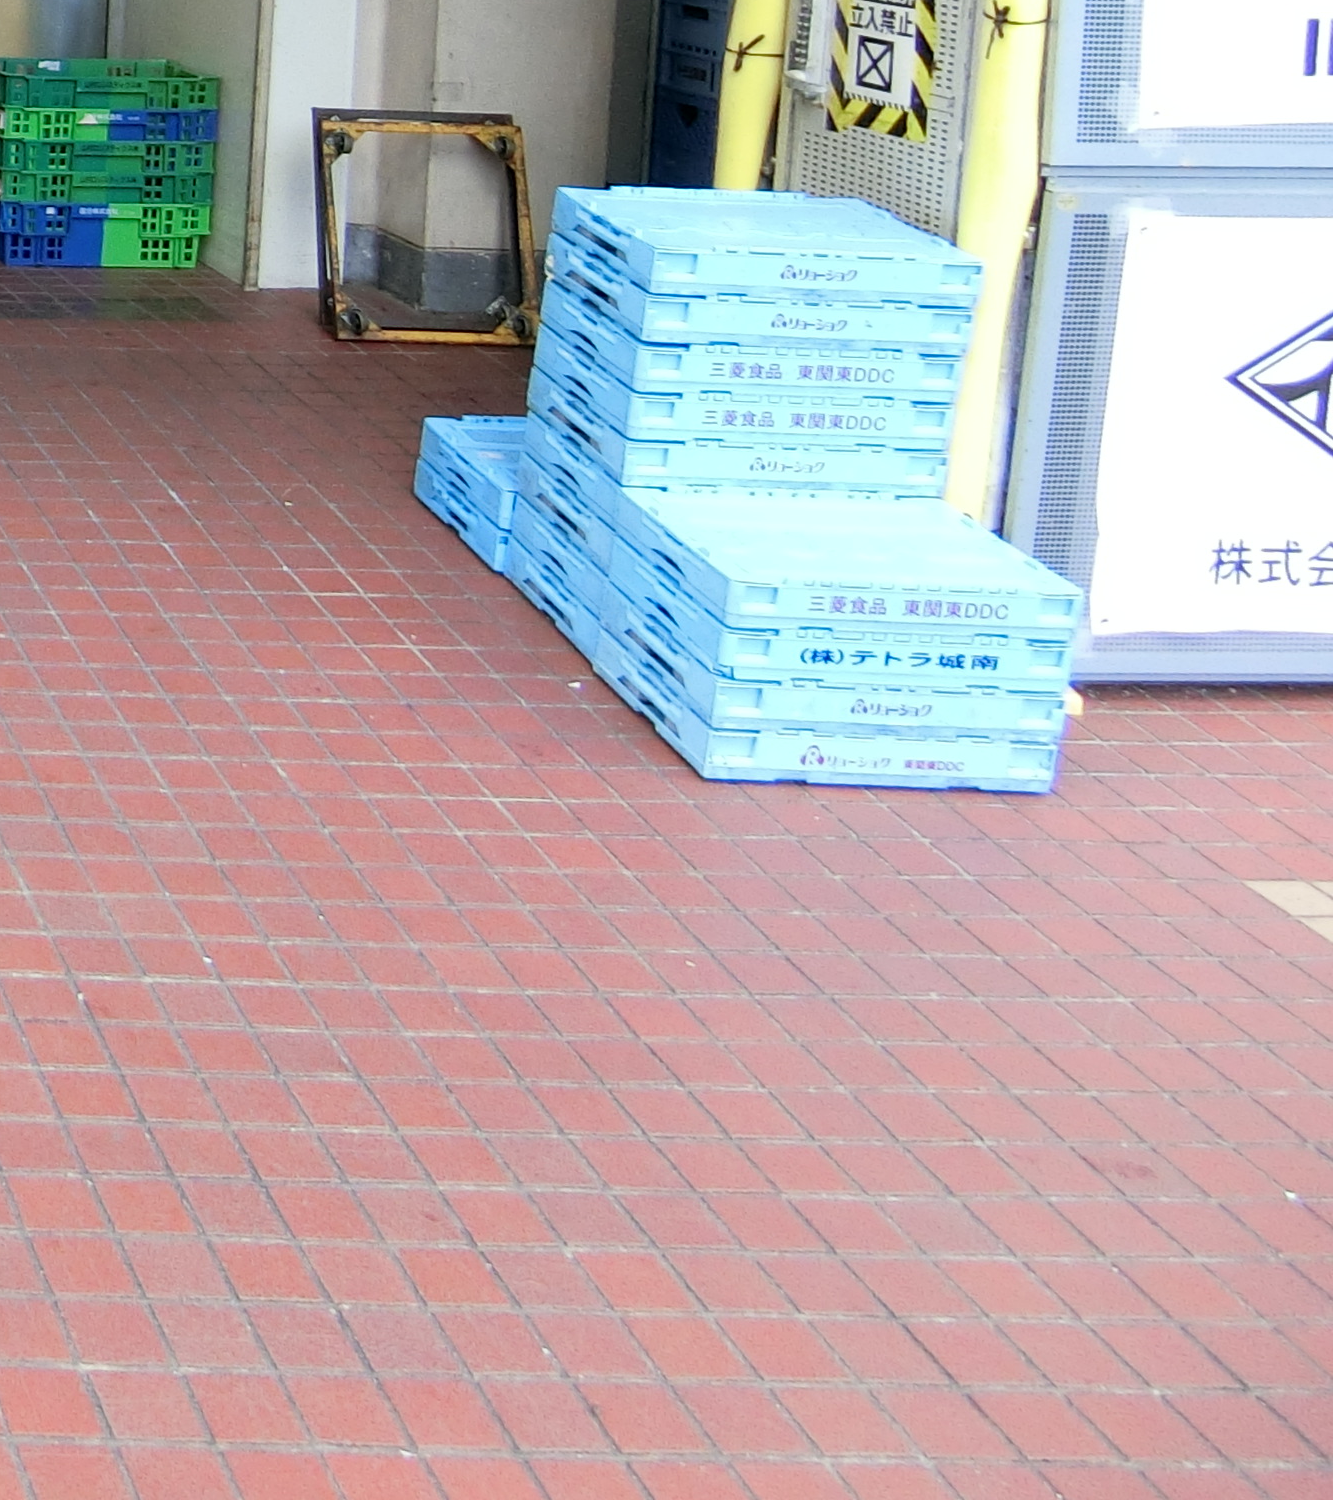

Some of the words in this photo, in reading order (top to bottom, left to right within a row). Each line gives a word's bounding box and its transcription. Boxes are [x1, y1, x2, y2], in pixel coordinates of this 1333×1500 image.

[848, 2, 915, 38] 立入禁止
[797, 268, 859, 283] リョーショク
[788, 317, 849, 332] リョーショク
[708, 361, 784, 381] 三菱食品
[796, 363, 897, 384] 東関東DDC
[701, 409, 776, 428] 三菱食品
[788, 411, 888, 432] 東関東DDC
[766, 460, 826, 474] リョーショク
[807, 595, 888, 616] 三菱食品
[902, 598, 1010, 621] 東関東DDC
[799, 648, 1001, 672] (株)テトラ城南
